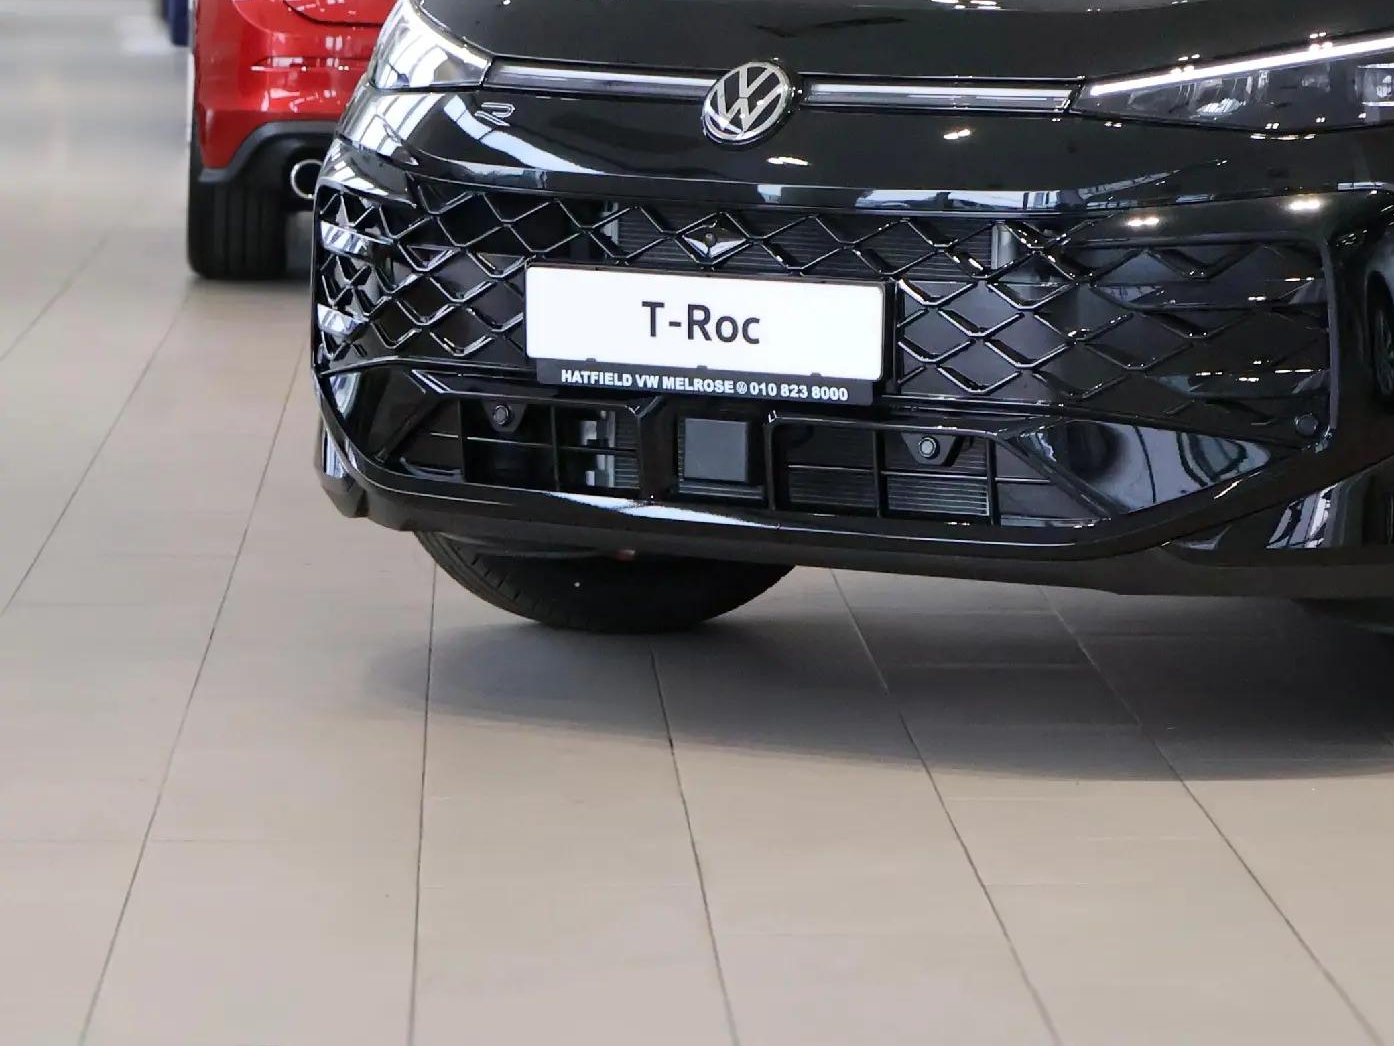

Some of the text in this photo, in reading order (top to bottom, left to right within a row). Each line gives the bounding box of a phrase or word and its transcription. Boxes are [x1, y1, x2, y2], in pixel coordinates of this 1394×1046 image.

[703, 60, 792, 144] VW
[641, 300, 761, 345] T-Roc
[561, 369, 633, 387] HATFIELD
[635, 374, 659, 389] VW
[662, 375, 734, 394] MELROSE
[749, 382, 777, 397] 010
[780, 384, 809, 399] 823
[811, 387, 849, 401] 8000
